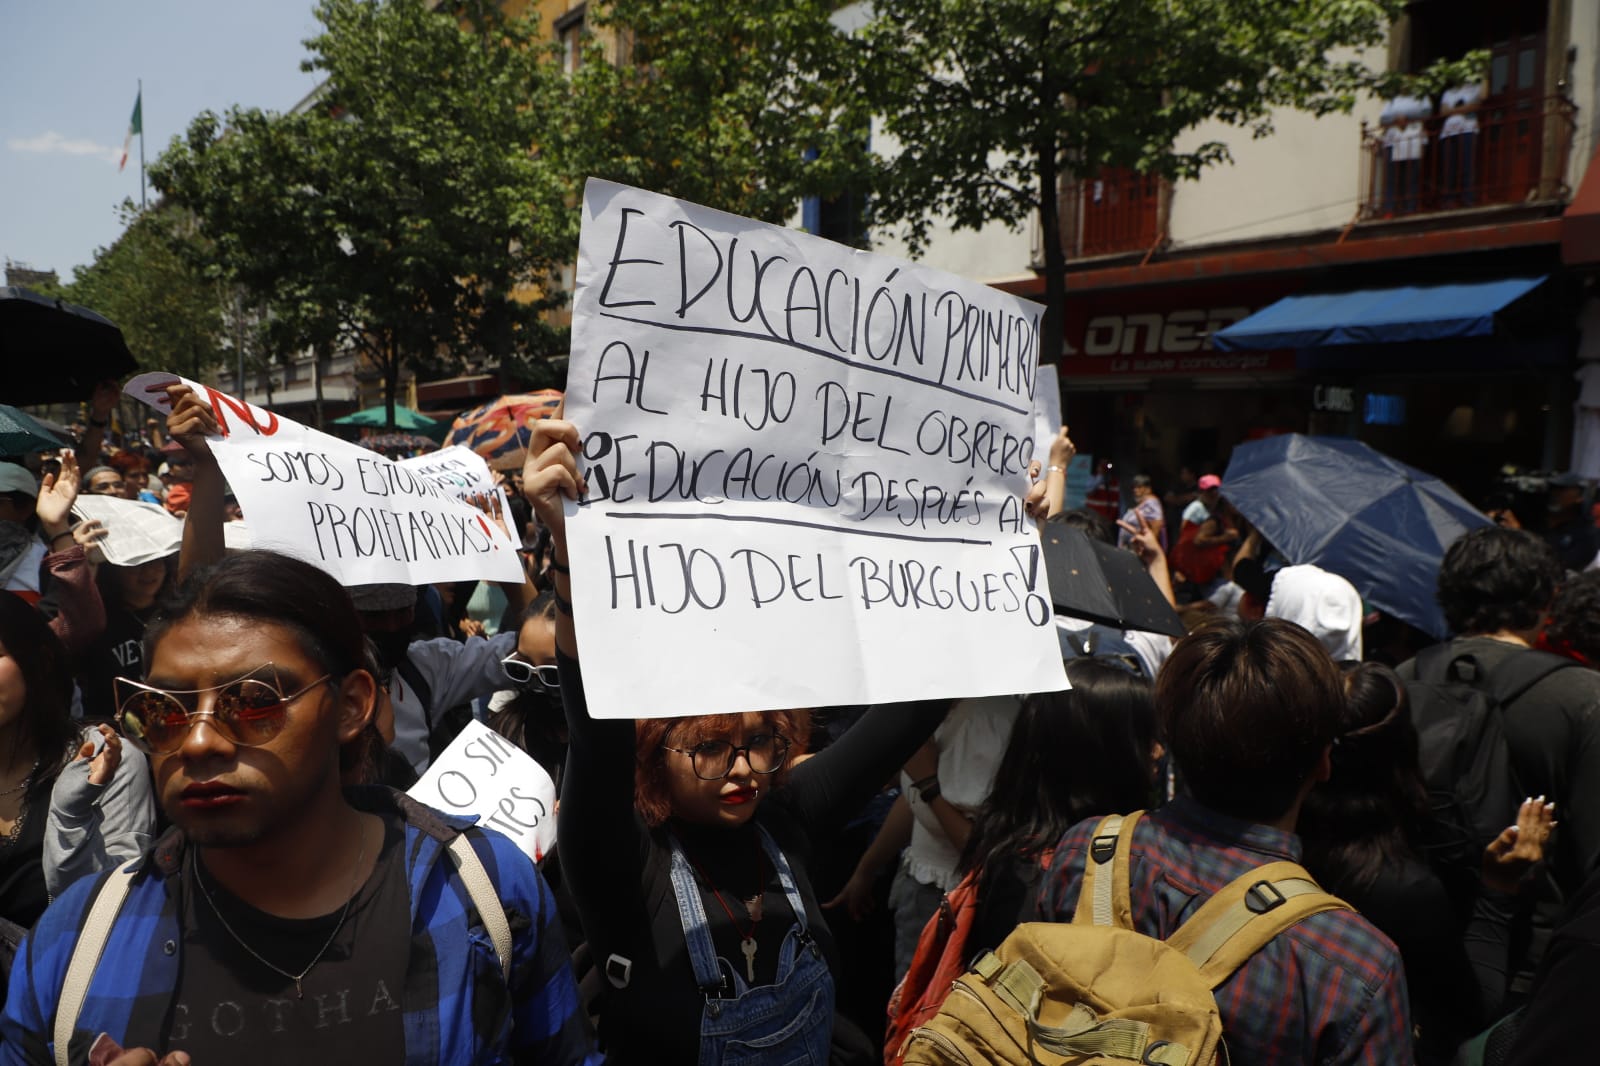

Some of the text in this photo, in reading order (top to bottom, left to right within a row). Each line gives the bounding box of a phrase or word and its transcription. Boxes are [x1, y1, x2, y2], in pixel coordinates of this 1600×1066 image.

[599, 207, 1040, 402] EDUCACIÓN PRIMERO
[593, 341, 1034, 476] AL HIJO DEL OBRERO
[247, 451, 344, 491] SOMOS
[851, 472, 985, 530] DESPUÉS
[999, 495, 1030, 535] AL
[605, 535, 1050, 626] HIJO DEL BURGUES!
